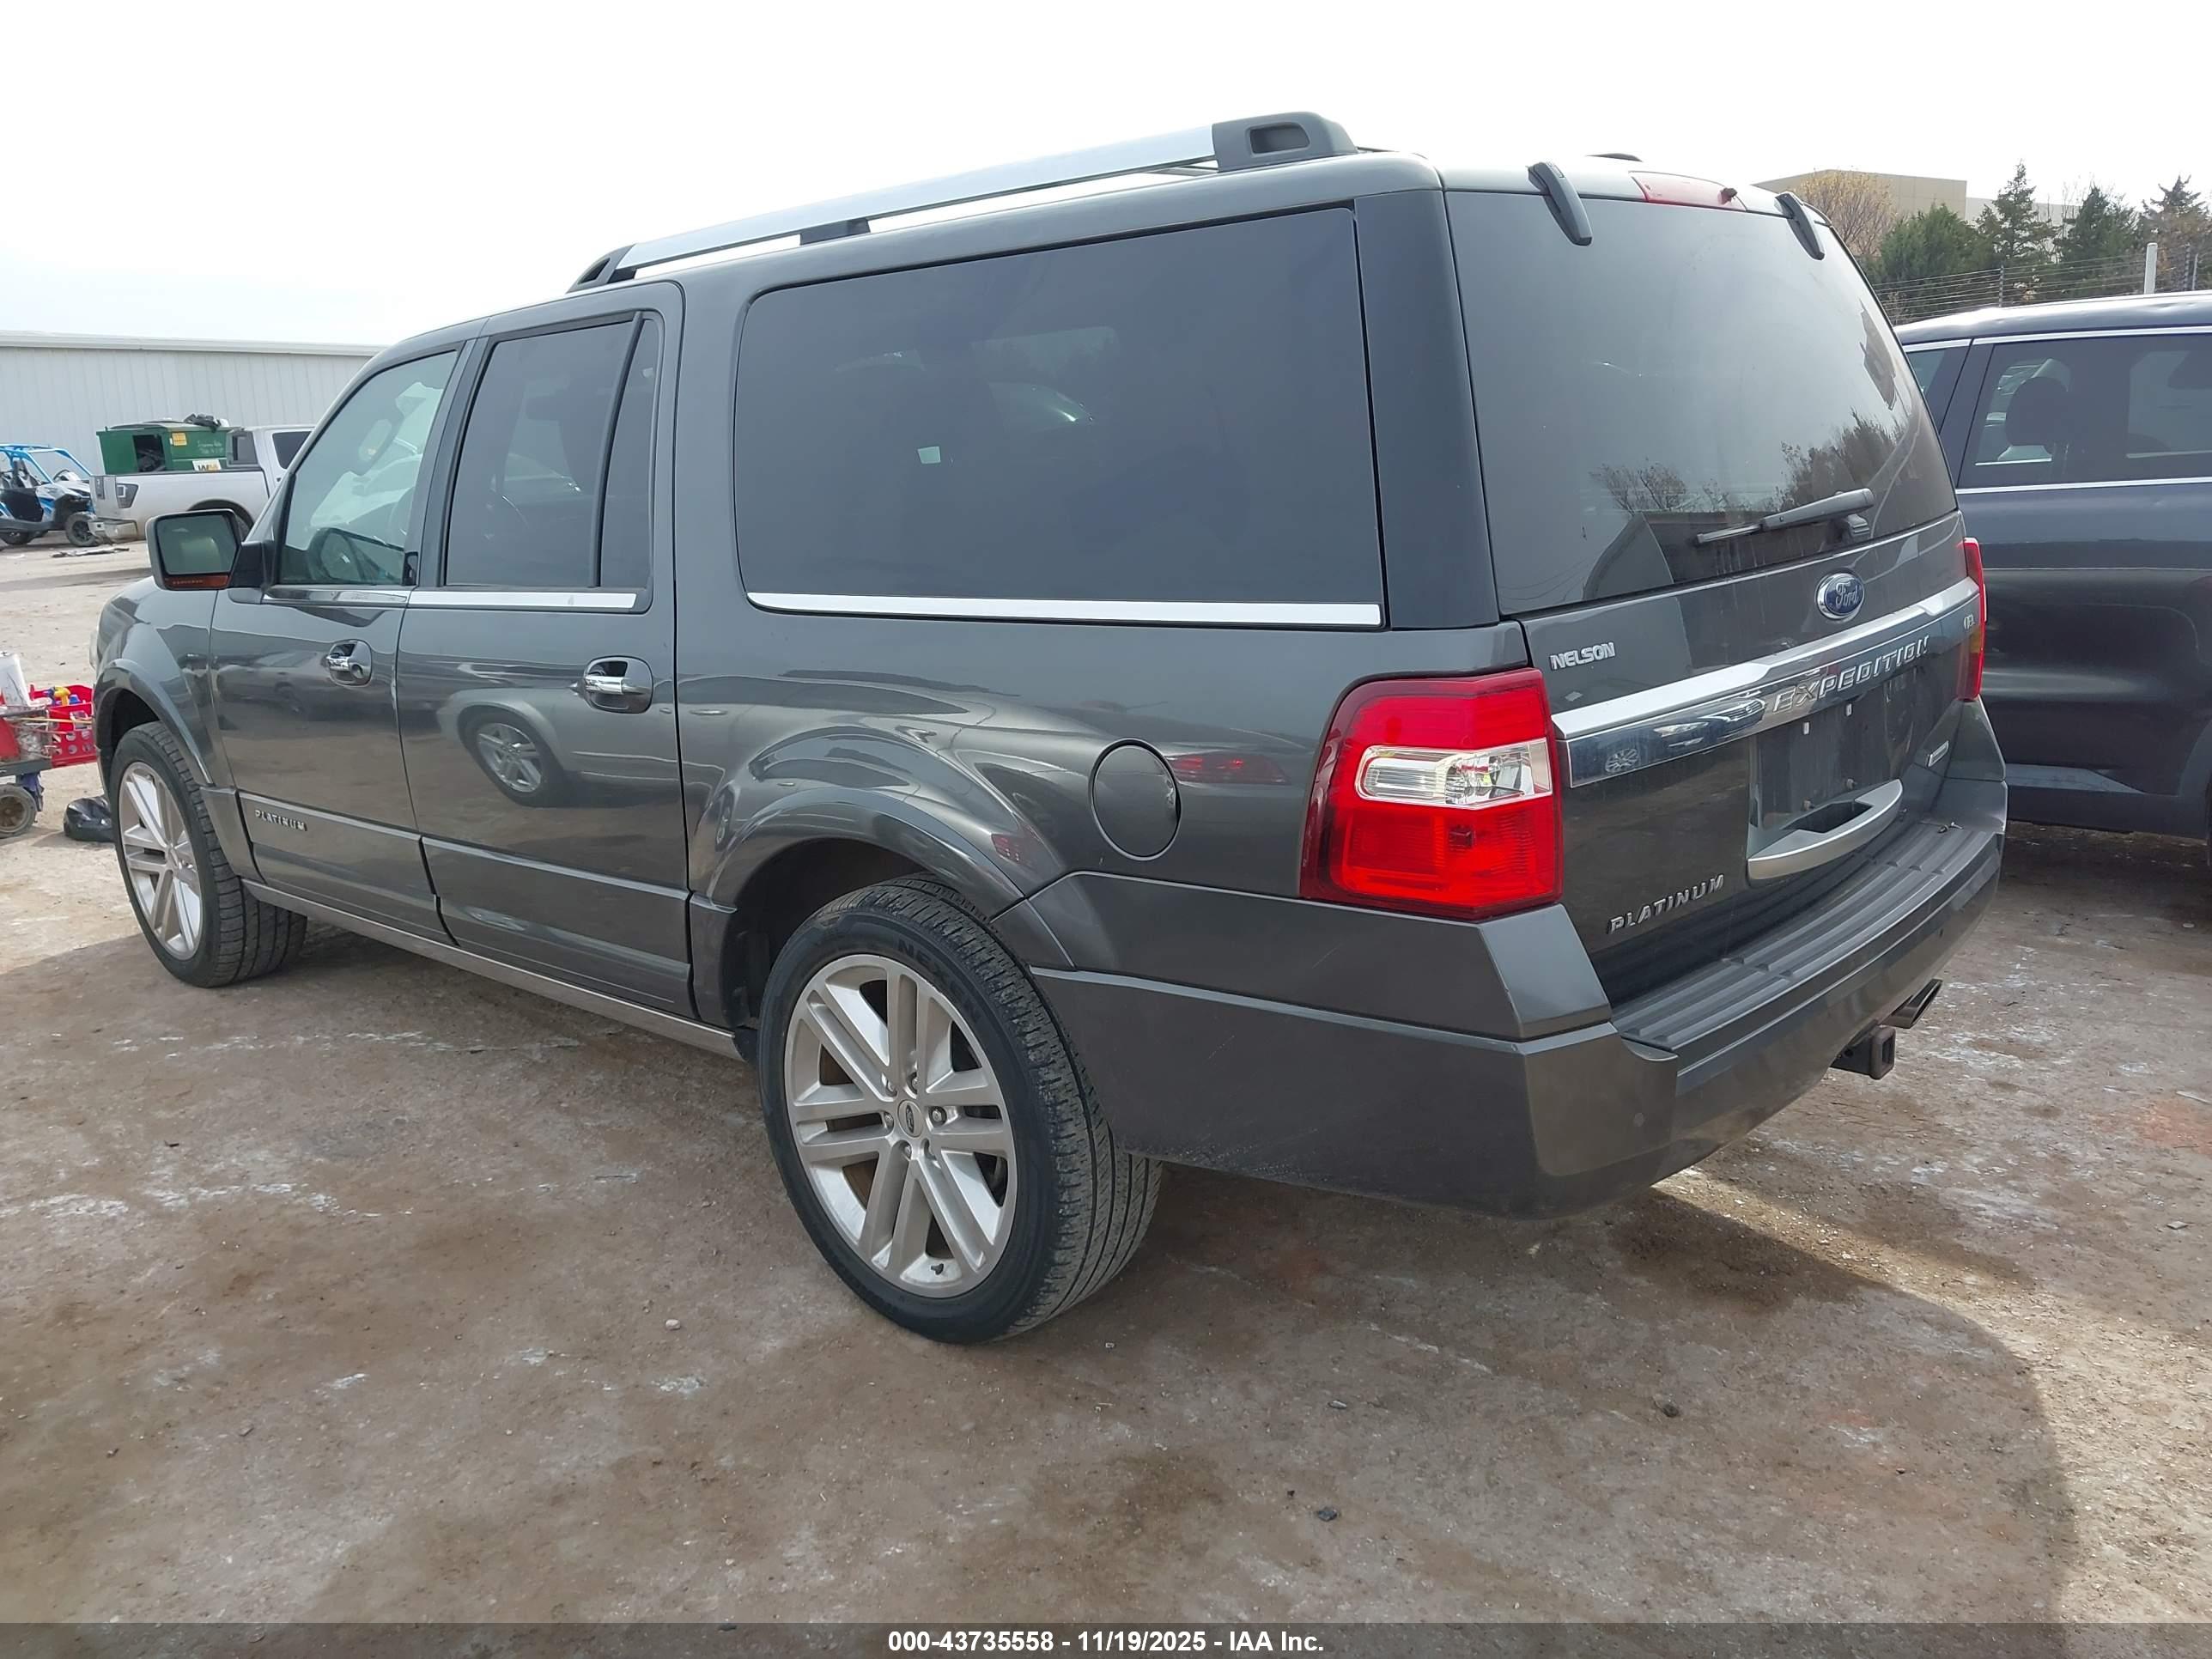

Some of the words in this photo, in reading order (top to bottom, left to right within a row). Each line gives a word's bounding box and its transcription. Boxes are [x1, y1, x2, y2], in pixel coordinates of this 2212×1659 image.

[1835, 581, 1859, 606] Ford
[1550, 642, 1616, 671] NELSON
[1772, 635, 1929, 713] EXPEDITION
[254, 810, 307, 831] PLATINUM
[1607, 873, 1725, 934] PLATINUM
